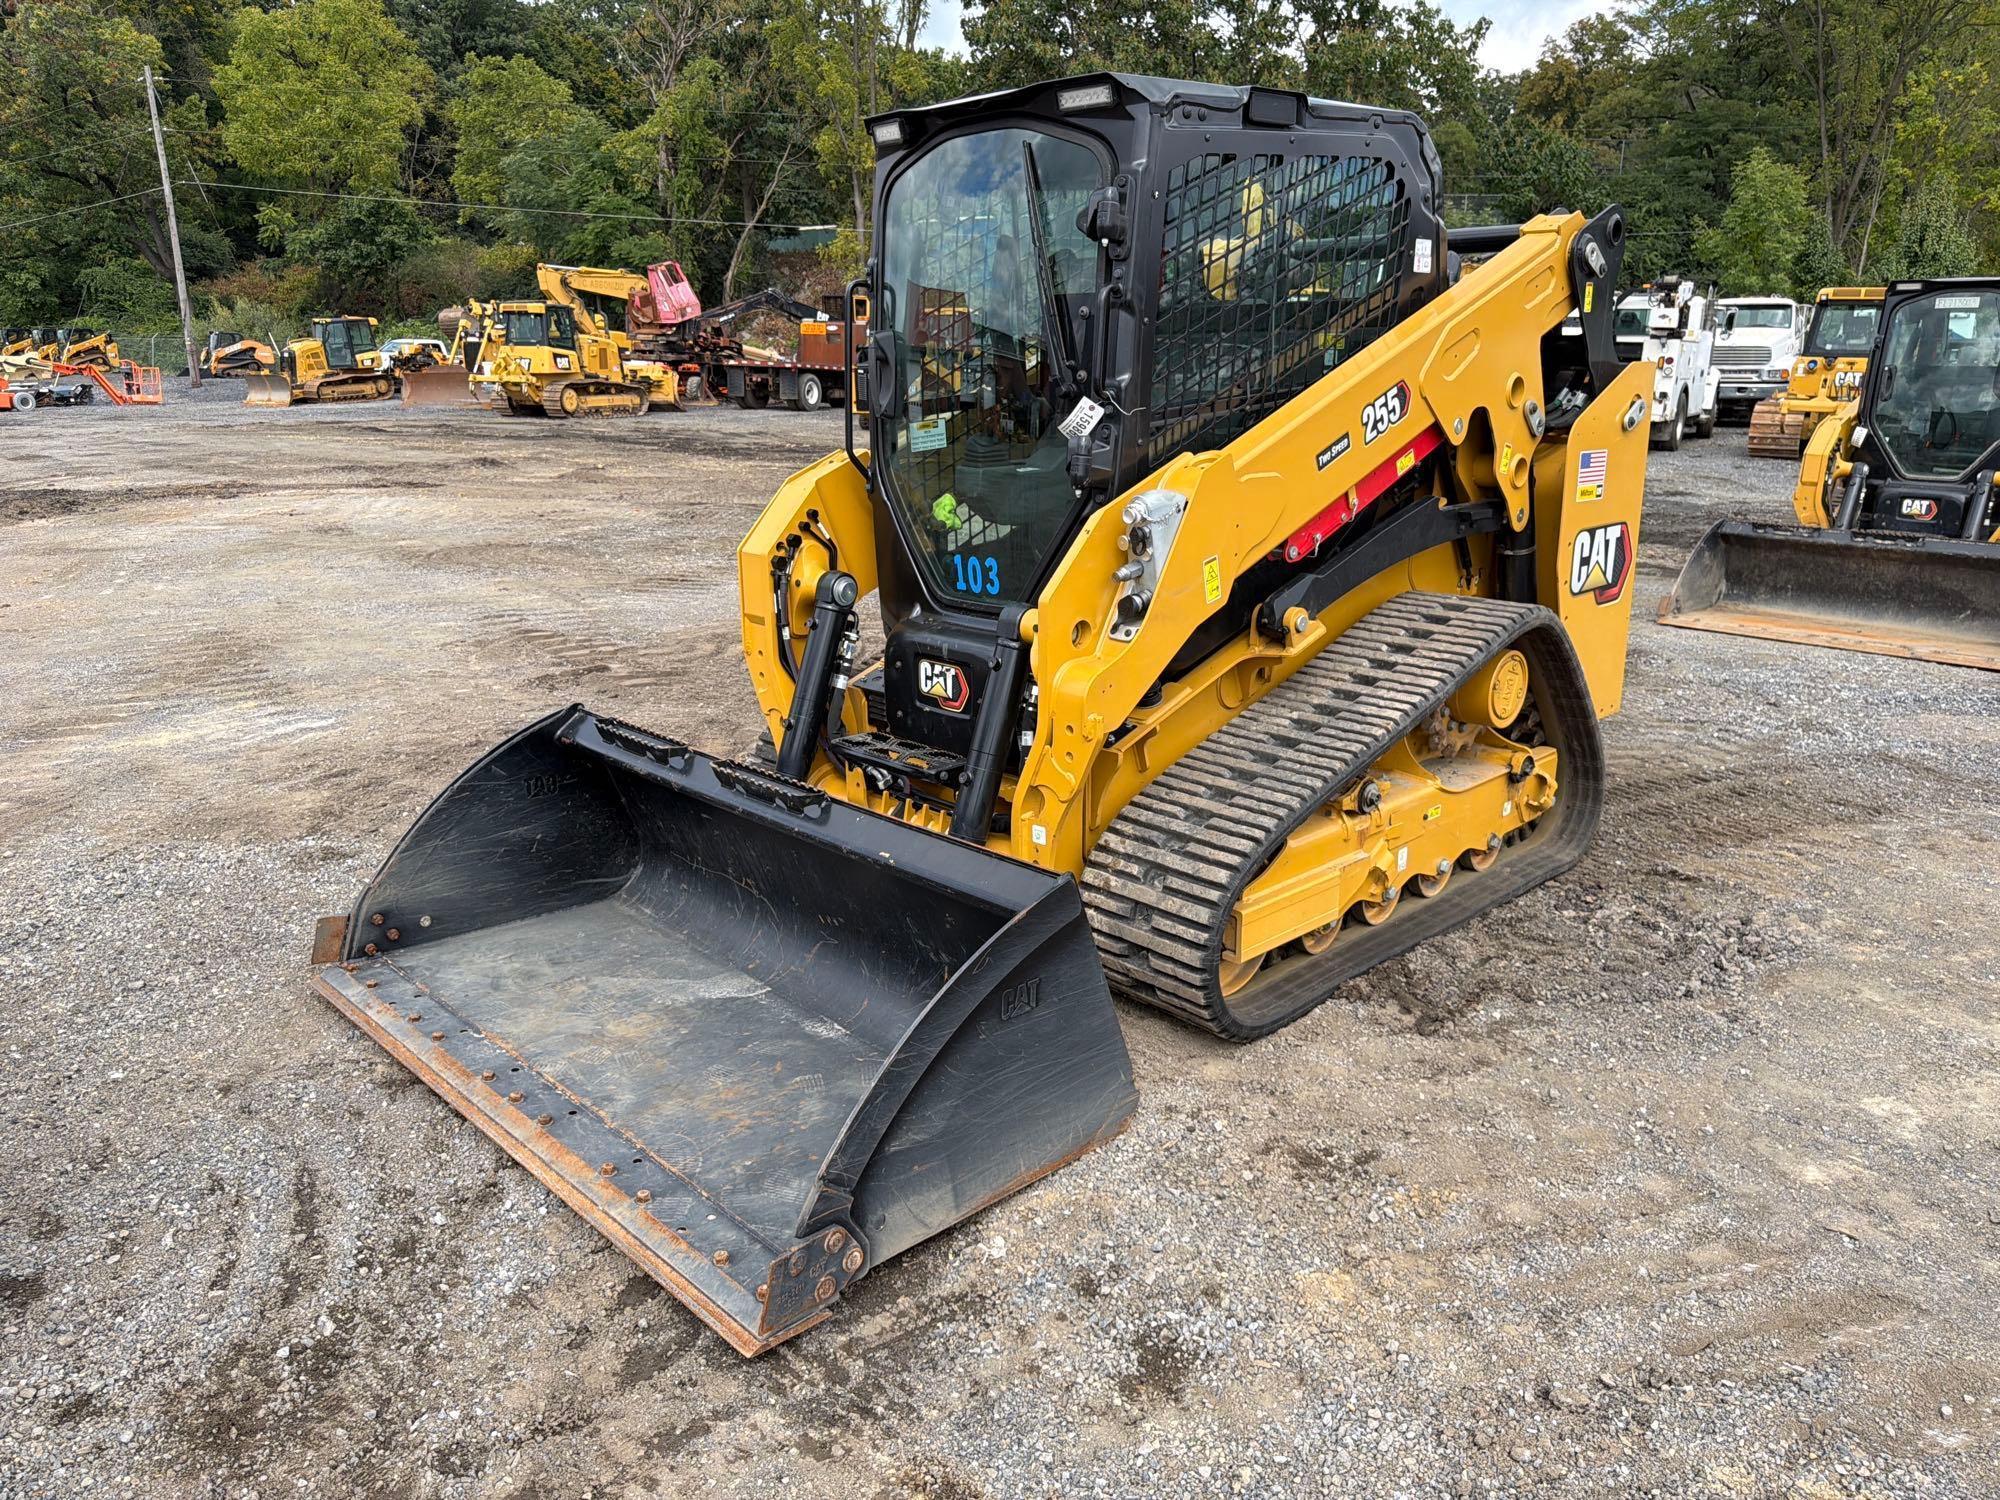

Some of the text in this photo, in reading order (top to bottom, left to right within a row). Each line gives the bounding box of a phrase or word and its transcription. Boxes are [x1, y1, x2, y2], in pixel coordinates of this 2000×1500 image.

[556, 357, 570, 369] CAT
[1835, 371, 1863, 387] CAT
[1361, 386, 1401, 444] 255
[1901, 499, 1930, 515] CAT
[953, 554, 1000, 595] 103
[1570, 524, 1622, 595] CAT
[920, 661, 956, 699] CAT
[1001, 977, 1041, 1020] CAT
